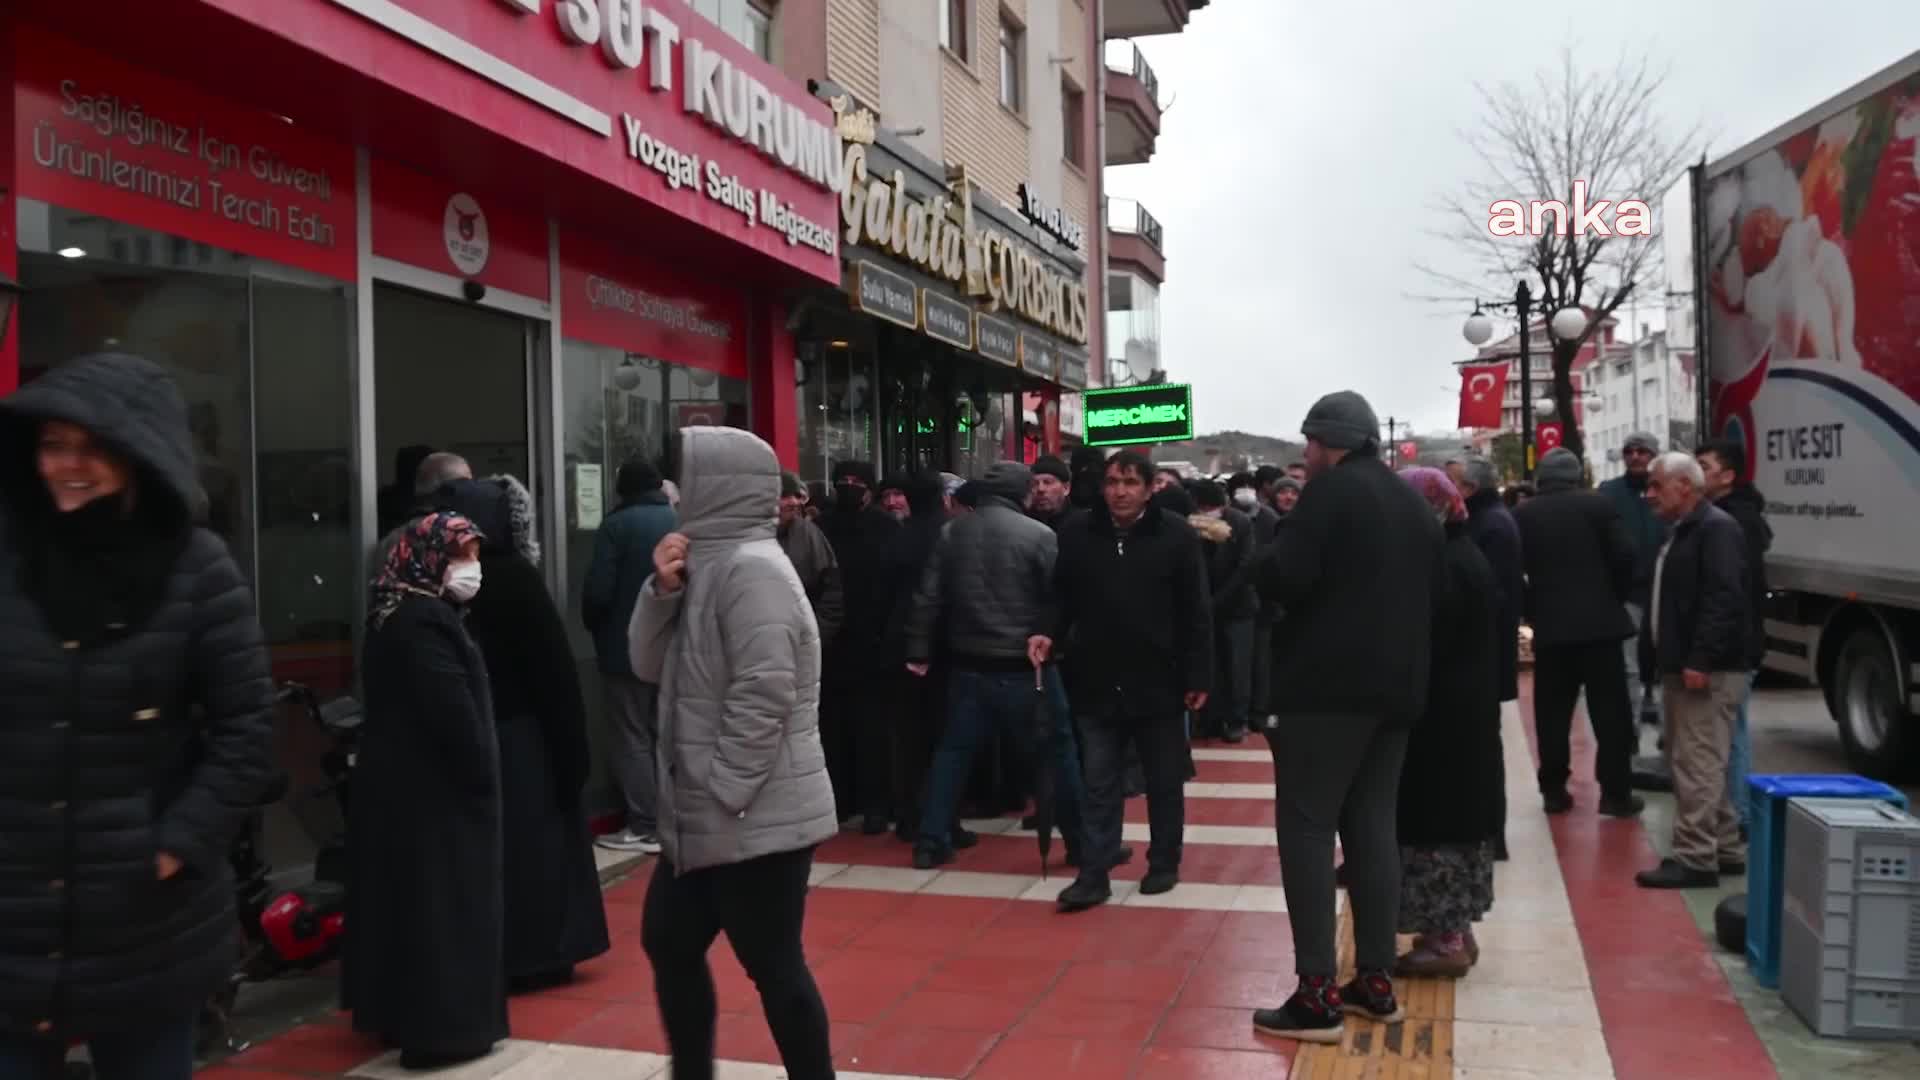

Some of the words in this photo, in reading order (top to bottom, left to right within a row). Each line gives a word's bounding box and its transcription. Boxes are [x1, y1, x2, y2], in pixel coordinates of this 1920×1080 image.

[60, 80, 191, 154] Sağlığınız
[683, 38, 843, 193] KURUMU
[33, 120, 200, 209] Ürünlerimizi
[209, 181, 281, 232] Tercih
[287, 207, 335, 248] Edin
[623, 112, 702, 191] Yozgat
[705, 160, 757, 226] Satış
[759, 188, 837, 257] Mağazası
[841, 143, 963, 280] Galata
[1767, 429, 1786, 462] ET
[1787, 426, 1809, 461] VE
